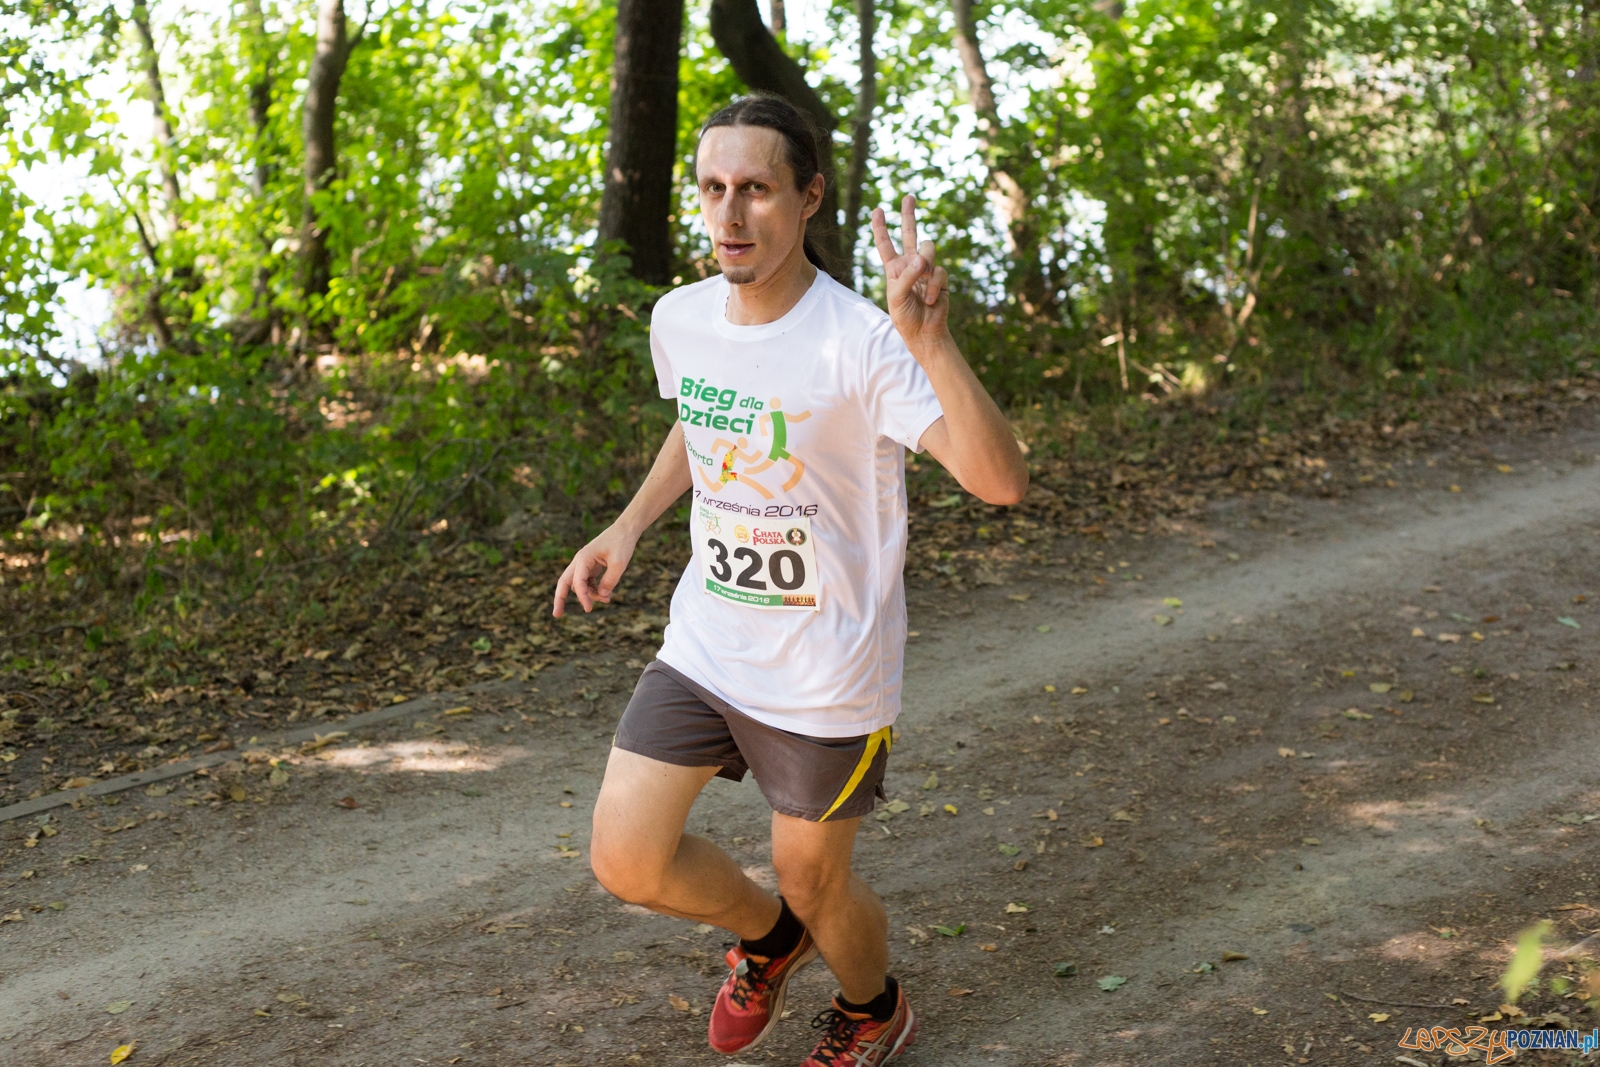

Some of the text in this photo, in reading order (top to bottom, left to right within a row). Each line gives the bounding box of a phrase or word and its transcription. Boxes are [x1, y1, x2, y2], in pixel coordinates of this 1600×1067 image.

[680, 376, 765, 411] Bieg dla
[680, 403, 755, 434] Dzieci
[683, 436, 714, 467] oberta
[764, 504, 819, 518] 2016
[753, 528, 783, 537] CHATA
[753, 537, 786, 546] POLSKA
[708, 538, 806, 590] 320
[713, 584, 721, 592] 17
